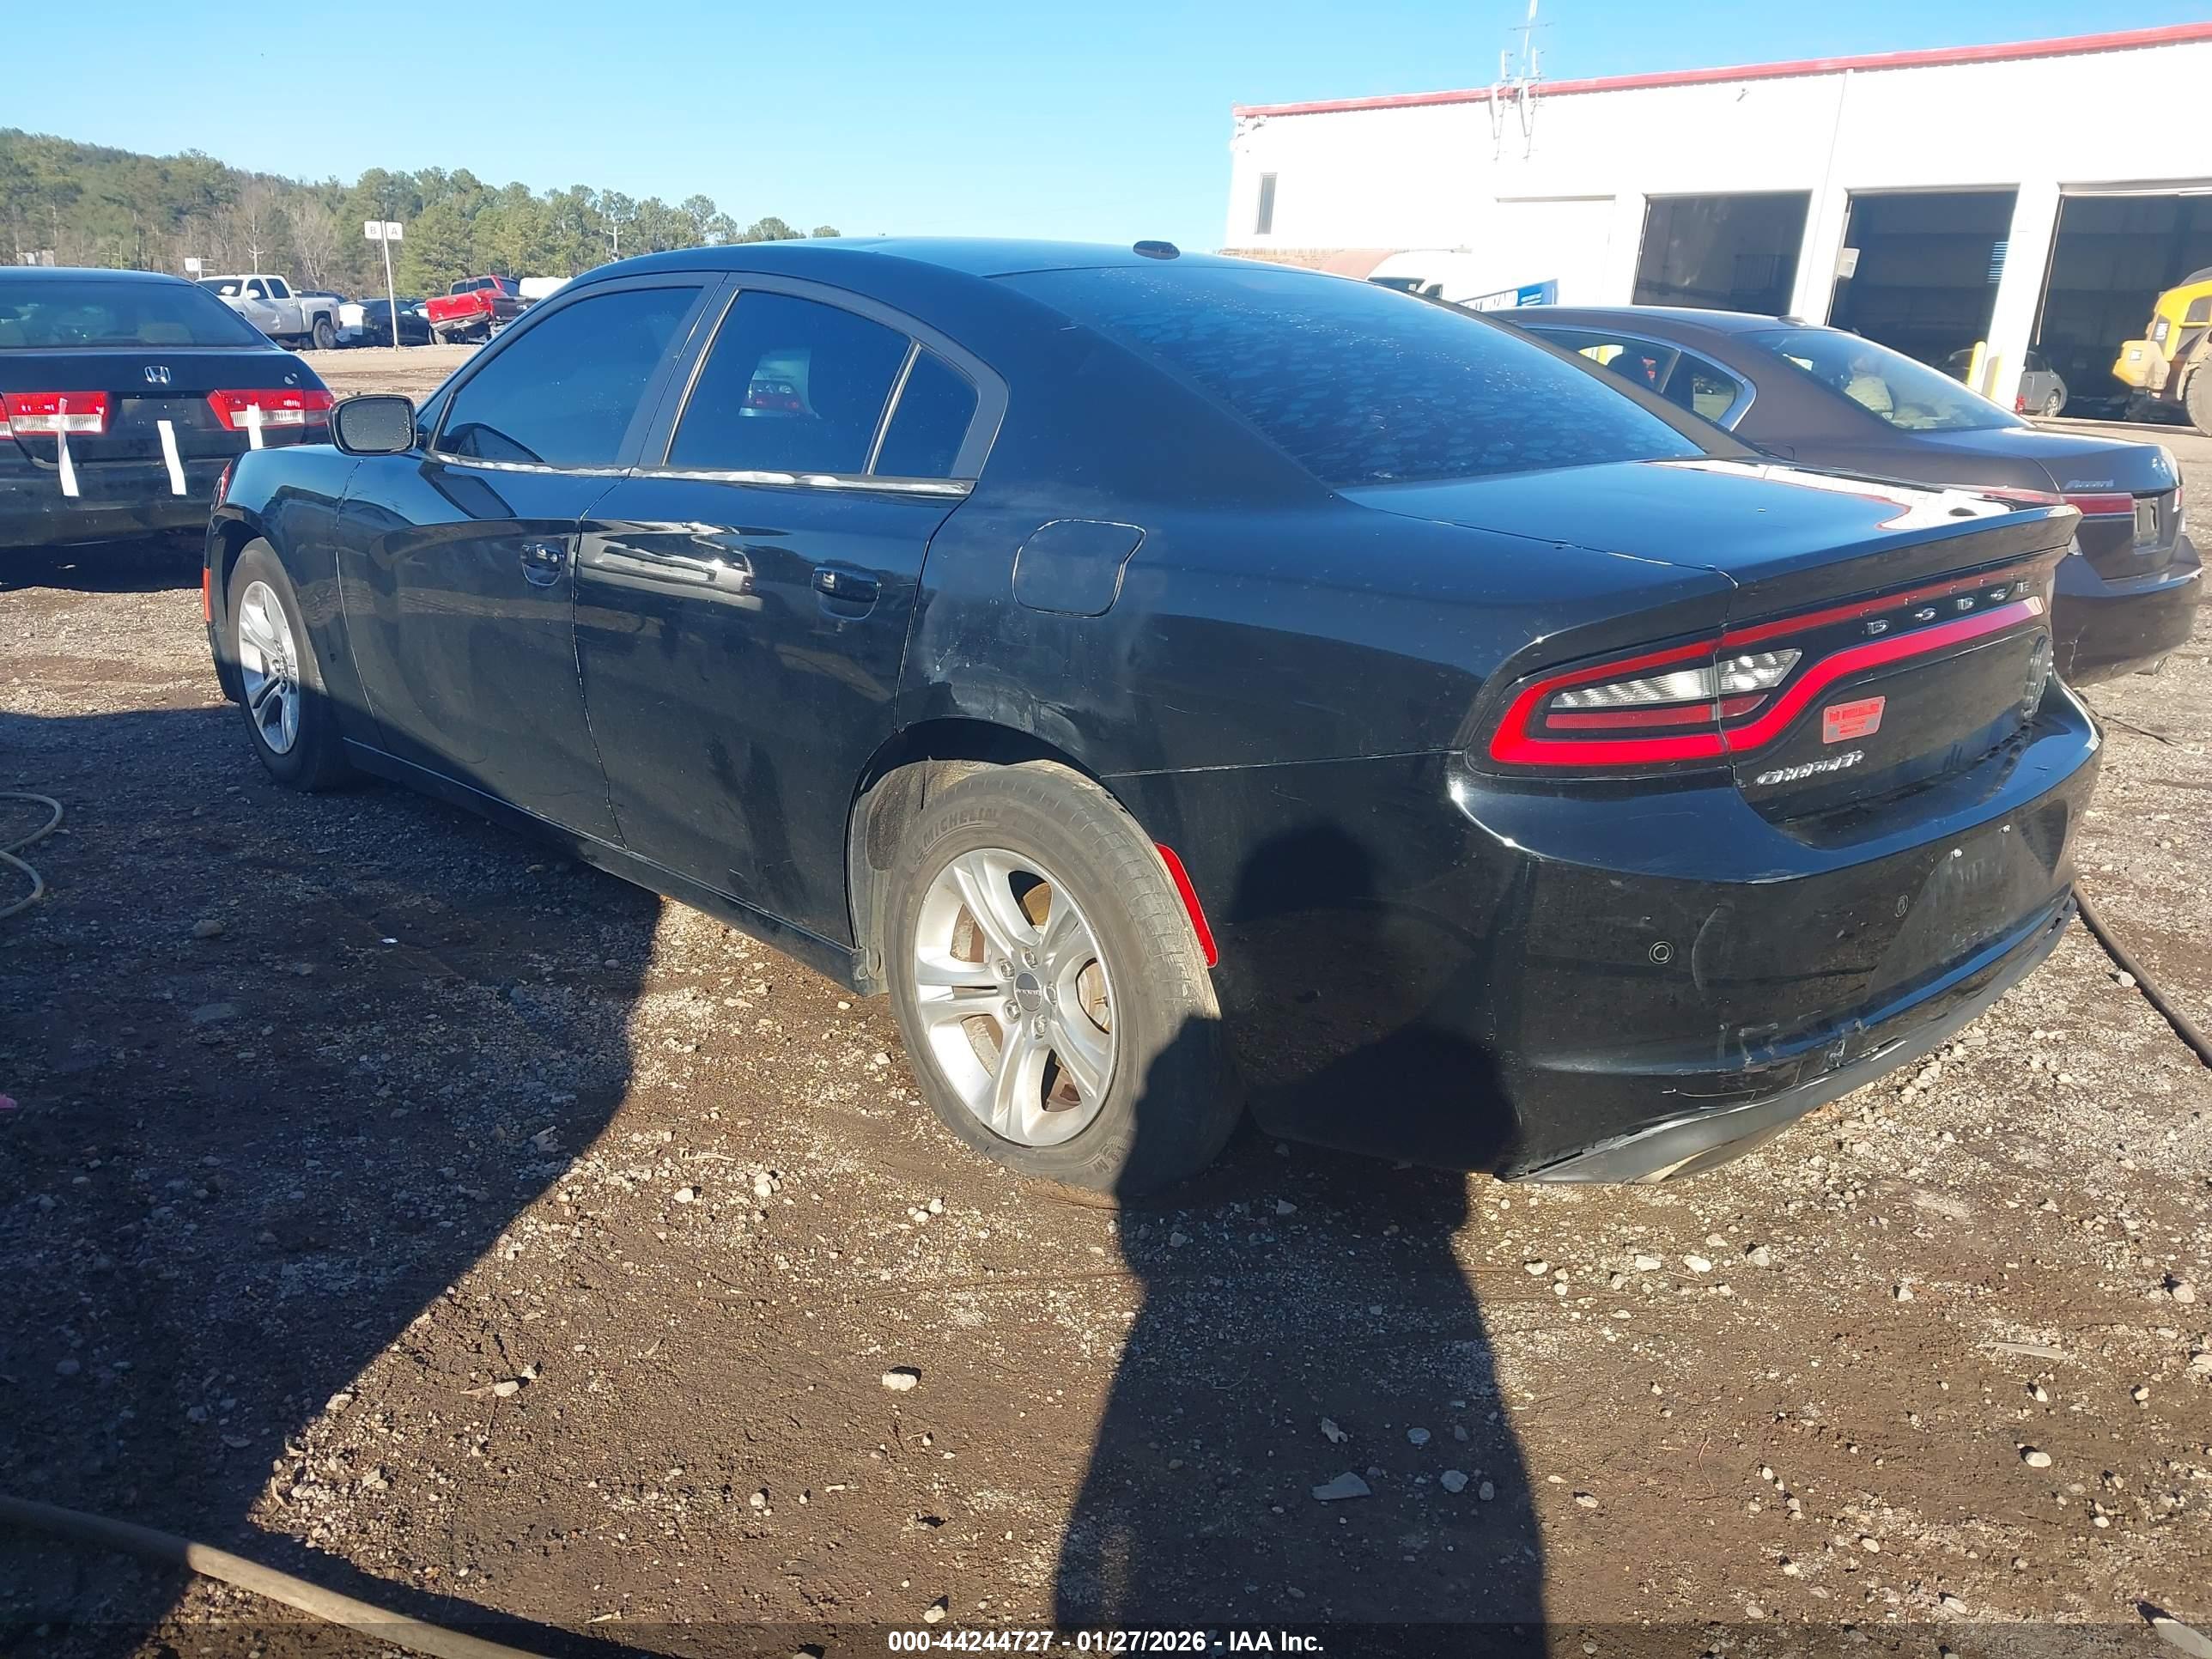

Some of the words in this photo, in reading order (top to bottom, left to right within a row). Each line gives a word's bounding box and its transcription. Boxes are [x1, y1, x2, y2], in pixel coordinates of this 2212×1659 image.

[370, 226, 378, 234] B
[391, 227, 398, 236] A
[1867, 580, 2030, 635] DODGE
[921, 807, 997, 848] MICHELIN
